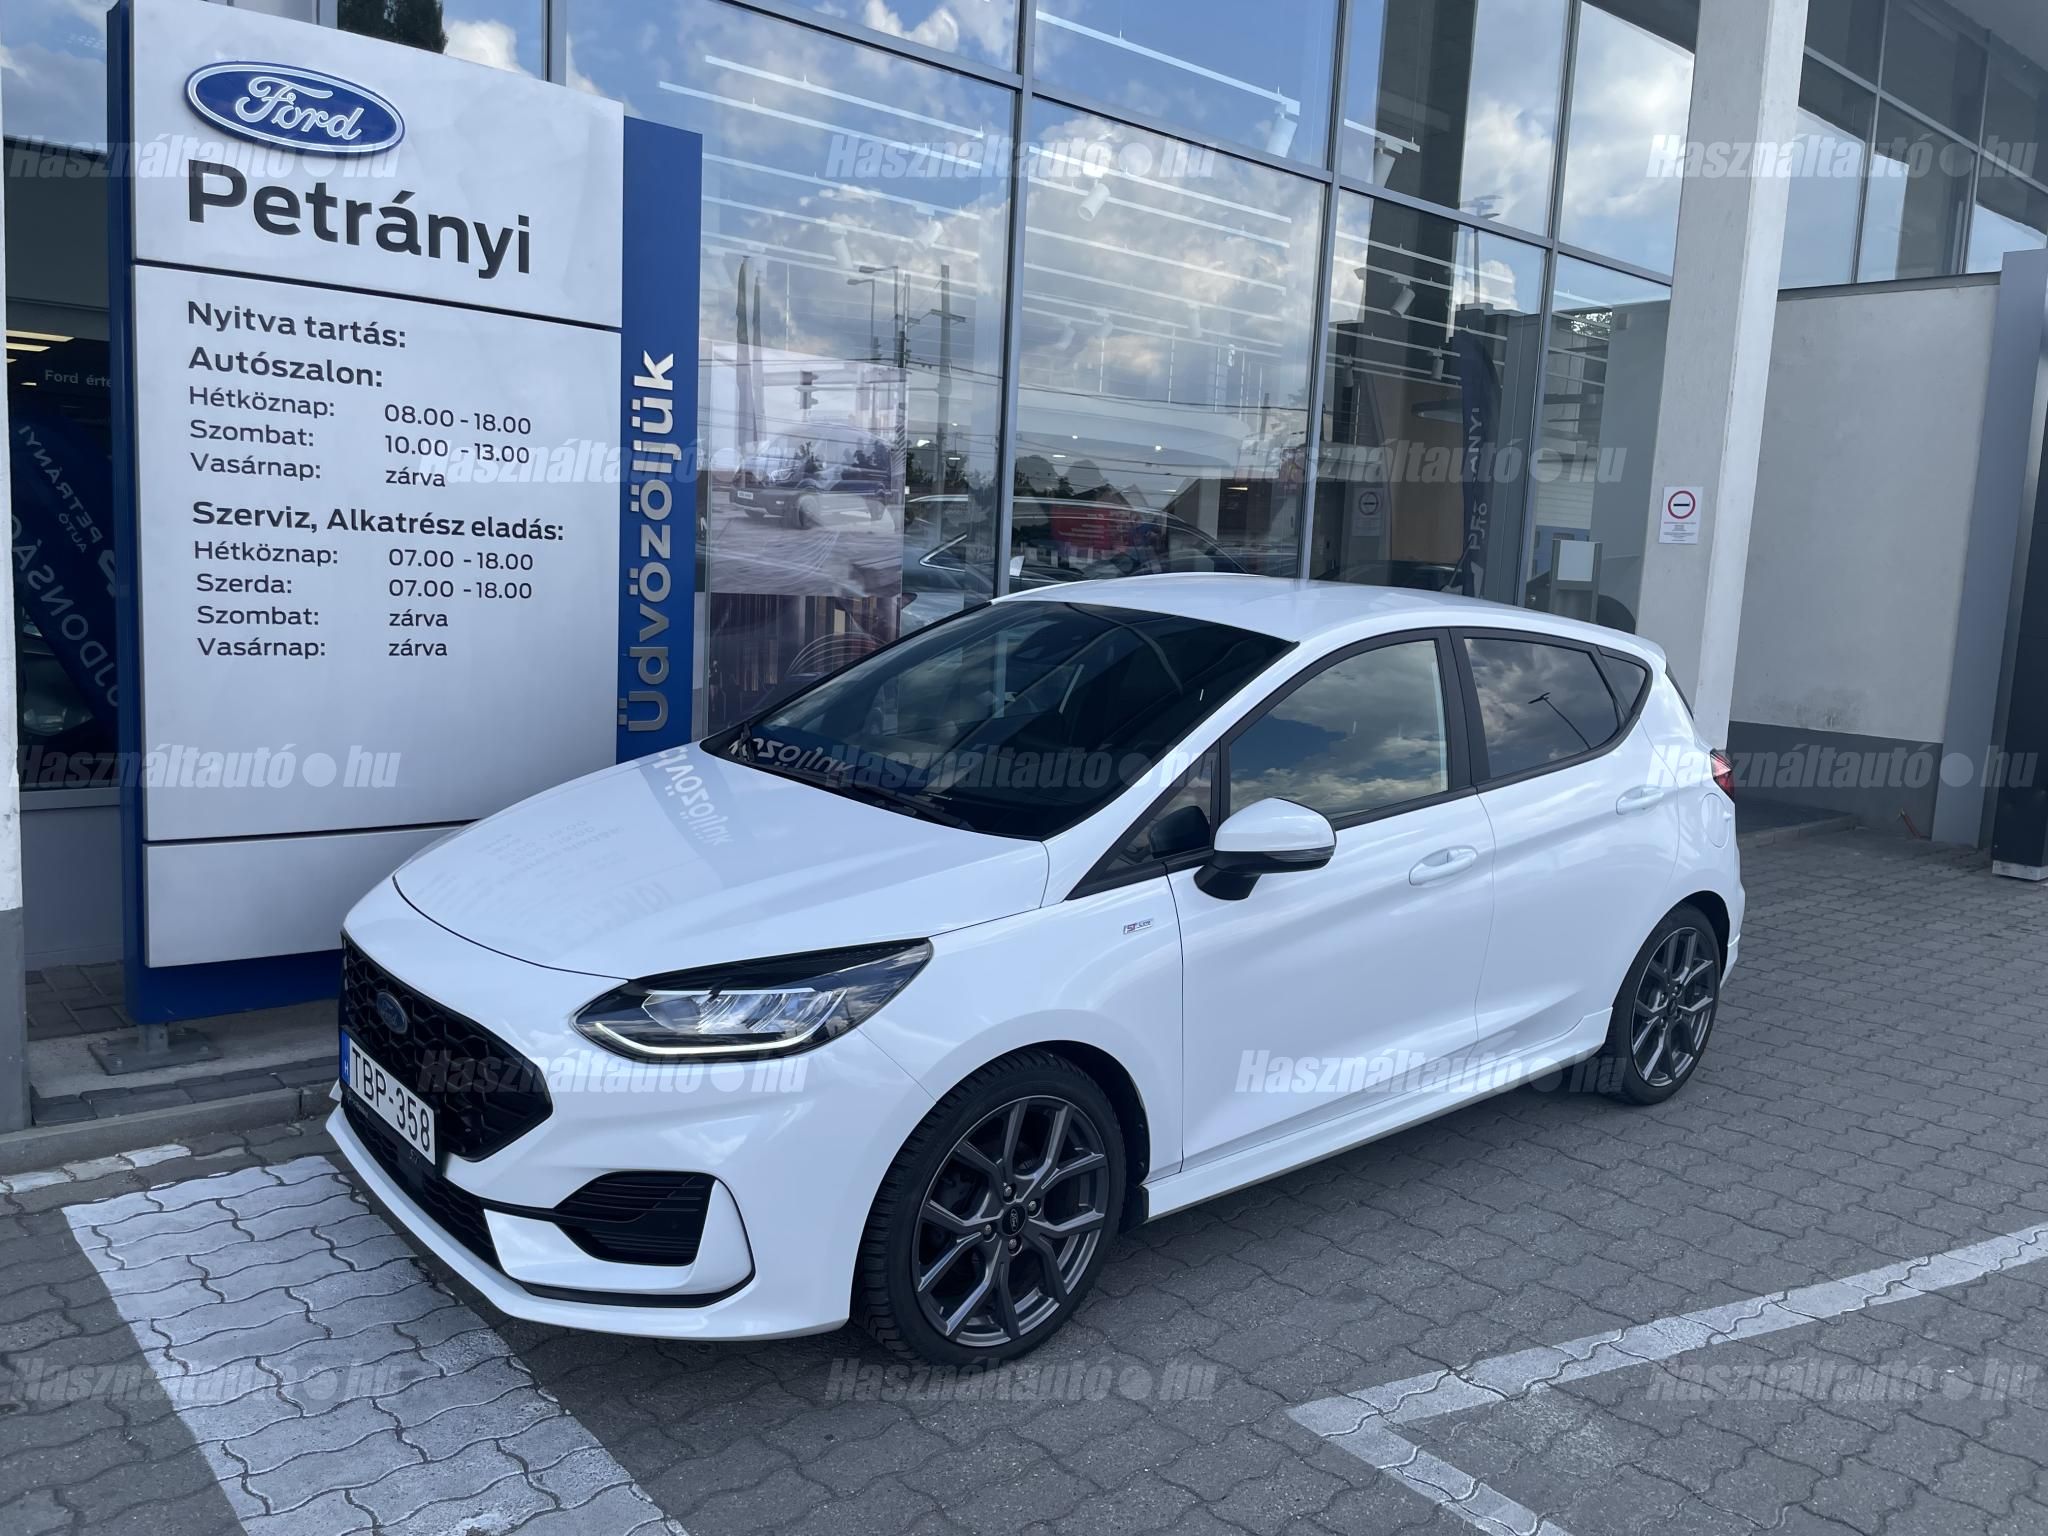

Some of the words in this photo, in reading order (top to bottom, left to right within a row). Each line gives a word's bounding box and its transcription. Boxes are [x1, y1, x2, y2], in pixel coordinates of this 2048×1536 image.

[235, 76, 364, 140] Ford
[188, 159, 530, 279] Petrányi
[188, 300, 296, 332] Nyitva
[305, 316, 406, 348] tartás:
[45, 369, 79, 384] Ford
[188, 346, 383, 387] Autószalon:
[189, 386, 335, 418] Hétköznap:
[385, 404, 454, 427] 08.00
[190, 419, 314, 447] Szombat:
[385, 435, 448, 457] 10.00
[190, 452, 321, 481] Vasárnap:
[385, 467, 446, 487] zárva
[192, 501, 318, 533] Szerviz,
[326, 508, 465, 536] Alkatrész
[471, 516, 564, 541] eladás:
[618, 349, 682, 732] Üdvözöljük
[194, 541, 338, 567] Hétköznap:
[389, 548, 454, 567] 07.00
[196, 573, 292, 594] Szerda:
[389, 579, 454, 597] 07.00
[197, 605, 319, 626] Szombat:
[389, 608, 448, 627] zárva
[197, 637, 326, 660] Vasárnap:
[388, 639, 448, 657] zárva
[352, 1047, 430, 1153] TBP-358
